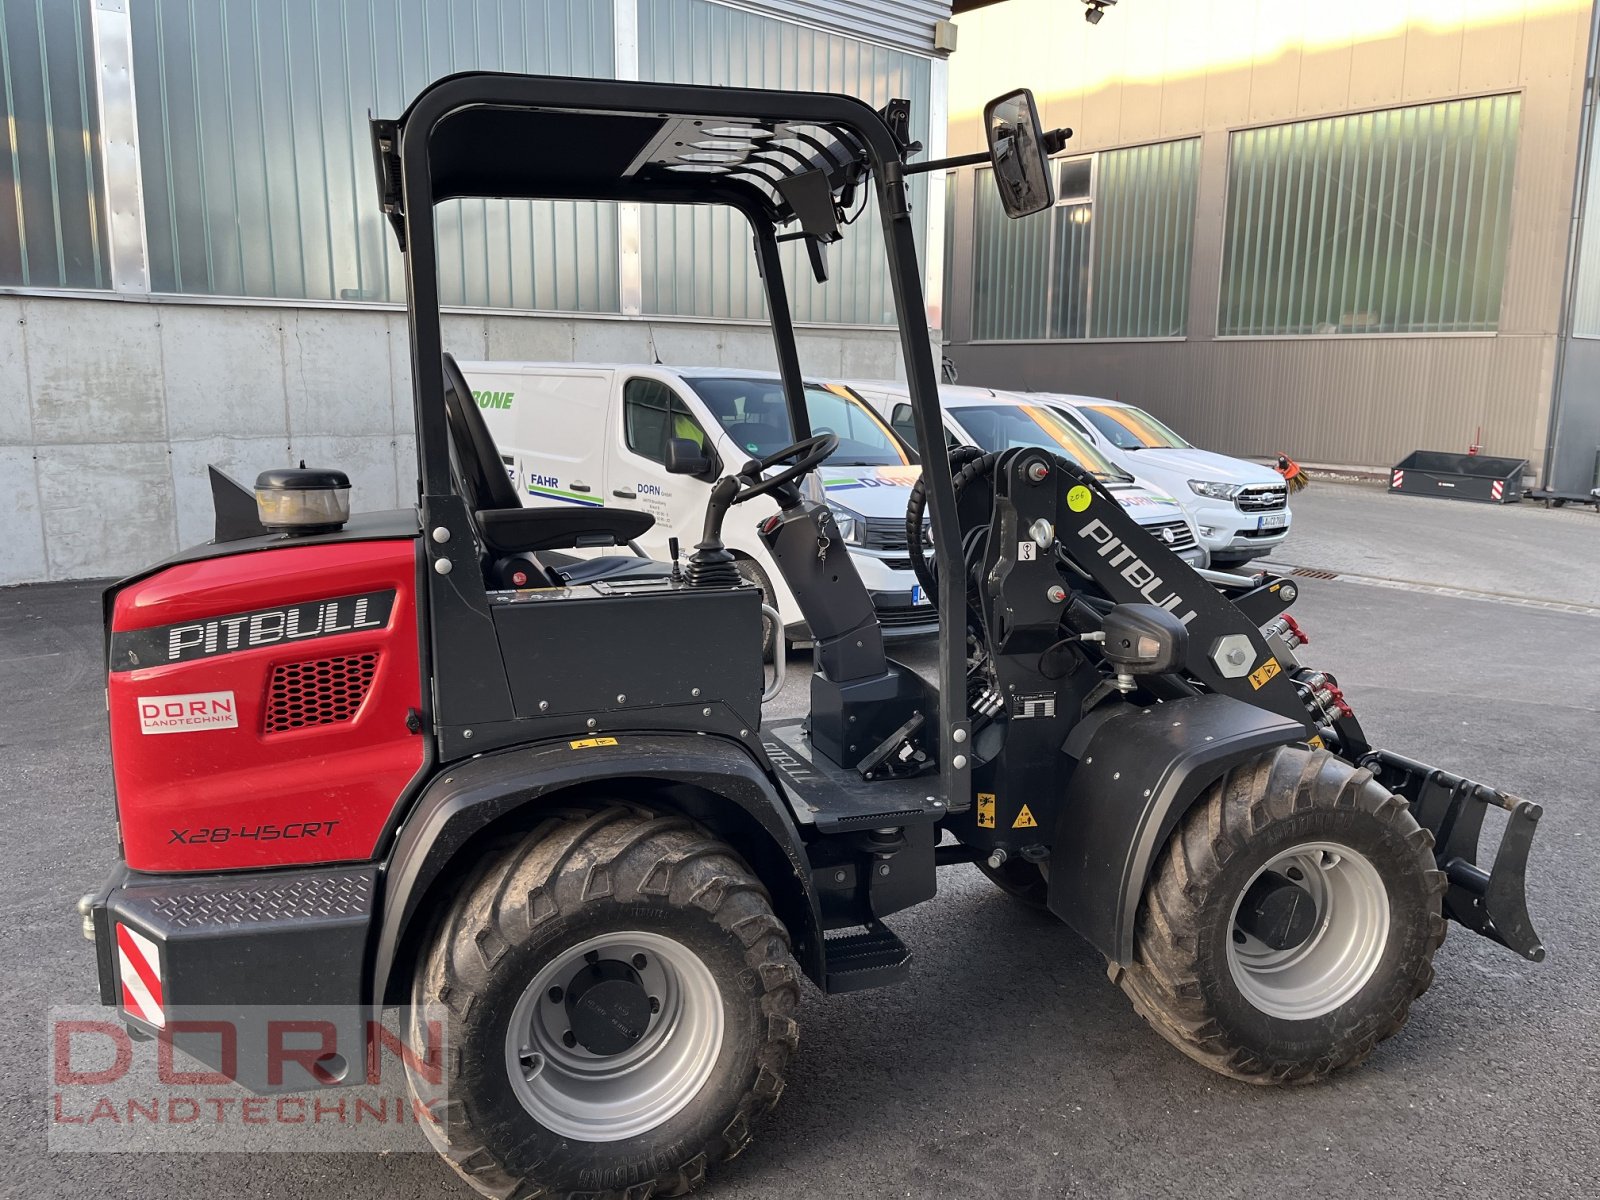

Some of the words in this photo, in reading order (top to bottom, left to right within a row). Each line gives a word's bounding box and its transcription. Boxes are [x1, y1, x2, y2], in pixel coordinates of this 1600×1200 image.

[531, 474, 559, 488] FAHR
[637, 483, 661, 496] DORN
[168, 598, 381, 660] PITBULL
[142, 698, 232, 719] DORN
[143, 714, 233, 728] LANDTECHNIK
[167, 820, 340, 845] X28-45CRT
